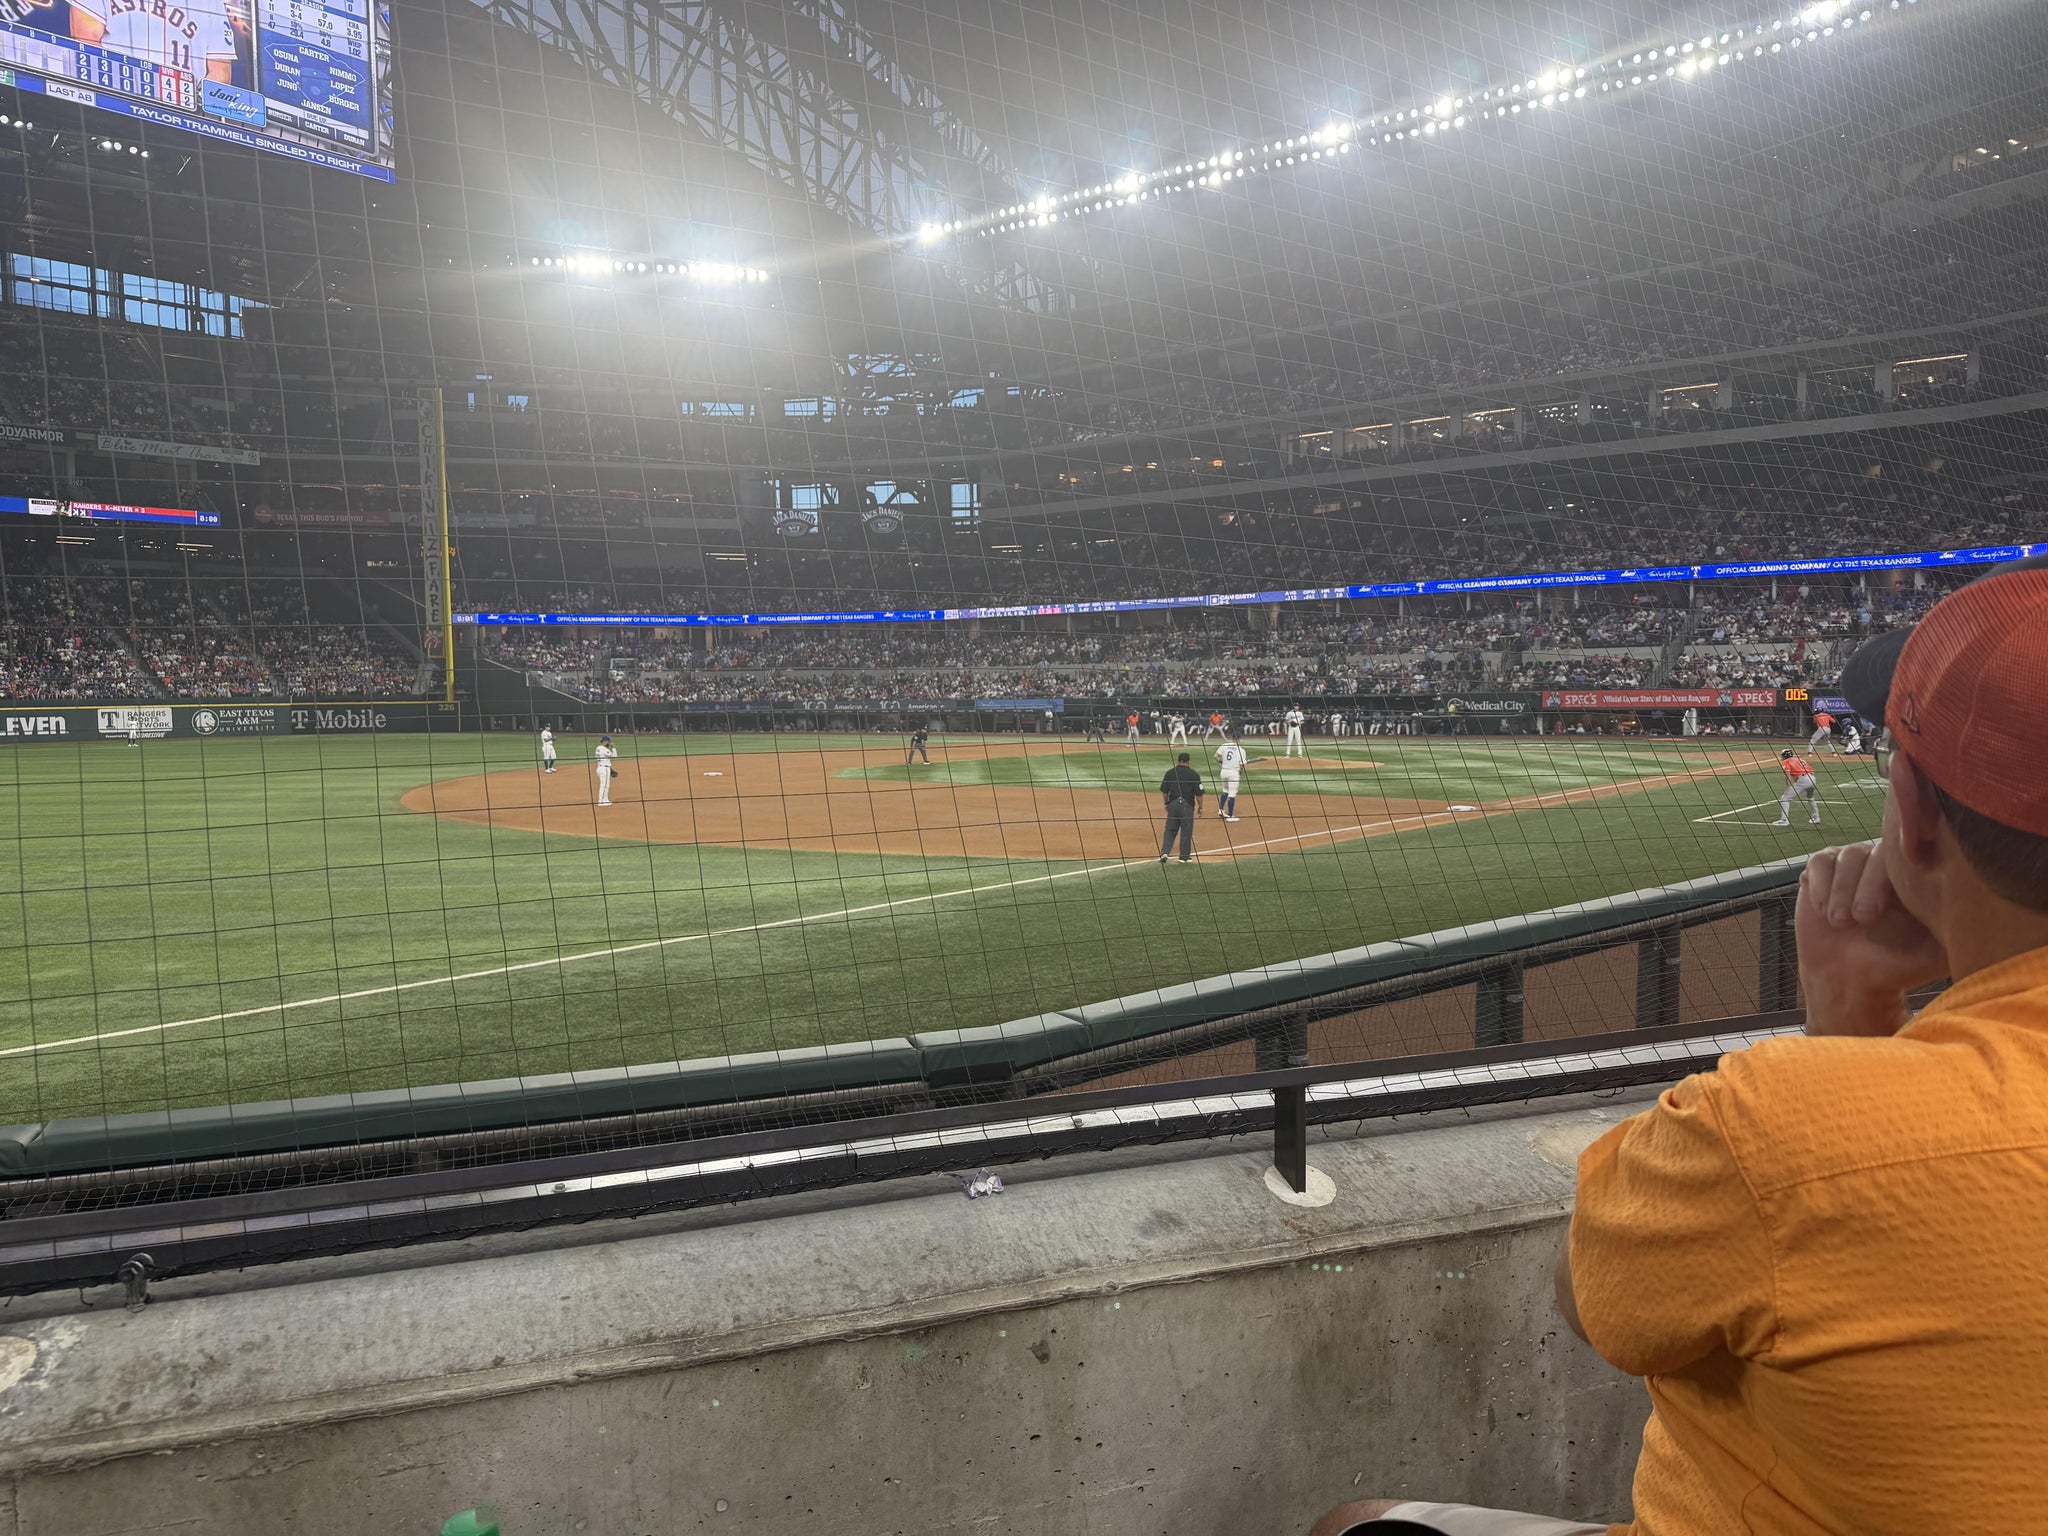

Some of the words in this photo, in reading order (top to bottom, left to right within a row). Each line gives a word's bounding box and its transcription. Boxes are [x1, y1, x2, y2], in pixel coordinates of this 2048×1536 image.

[171, 40, 191, 70] 11
[274, 49, 299, 63] OSUNA
[299, 46, 330, 62] CARTER
[79, 54, 86, 65] 2
[101, 60, 108, 71] 3
[122, 66, 129, 76] 0
[144, 71, 150, 81] 0
[165, 78, 172, 89] 4
[183, 83, 190, 93] 2
[275, 62, 300, 76] DURAN
[329, 66, 357, 82] NIMMO
[80, 68, 87, 80] 2
[102, 74, 109, 85] 4
[123, 80, 130, 91] 0
[144, 86, 151, 96] 2
[165, 91, 172, 102] 4
[184, 96, 191, 107] 2
[277, 79, 298, 91] JUNG
[330, 80, 355, 94] LOPEZ
[49, 85, 75, 97] LAST
[78, 92, 92, 102] AB
[301, 99, 332, 115] JANSEN
[329, 94, 360, 112] BURGER
[130, 105, 182, 126] TAYLOR
[184, 119, 254, 144] TRAMMELL
[255, 138, 307, 157] SINGLED
[309, 151, 325, 162] TO
[327, 157, 361, 171] RIGHT
[74, 502, 102, 511] RANGERS
[1565, 693, 1597, 705] SPEC'S
[1737, 690, 1773, 703] SPEC'S
[220, 710, 243, 718] EAST
[245, 709, 275, 717] TEXAS
[438, 703, 455, 712] 326
[1465, 700, 1502, 711] Medical
[1504, 700, 1525, 713] City
[0, 716, 66, 736] EVEn
[235, 717, 259, 725] A&M
[291, 710, 308, 729] T
[315, 709, 387, 729] Mobile
[1226, 751, 1233, 761] 6
